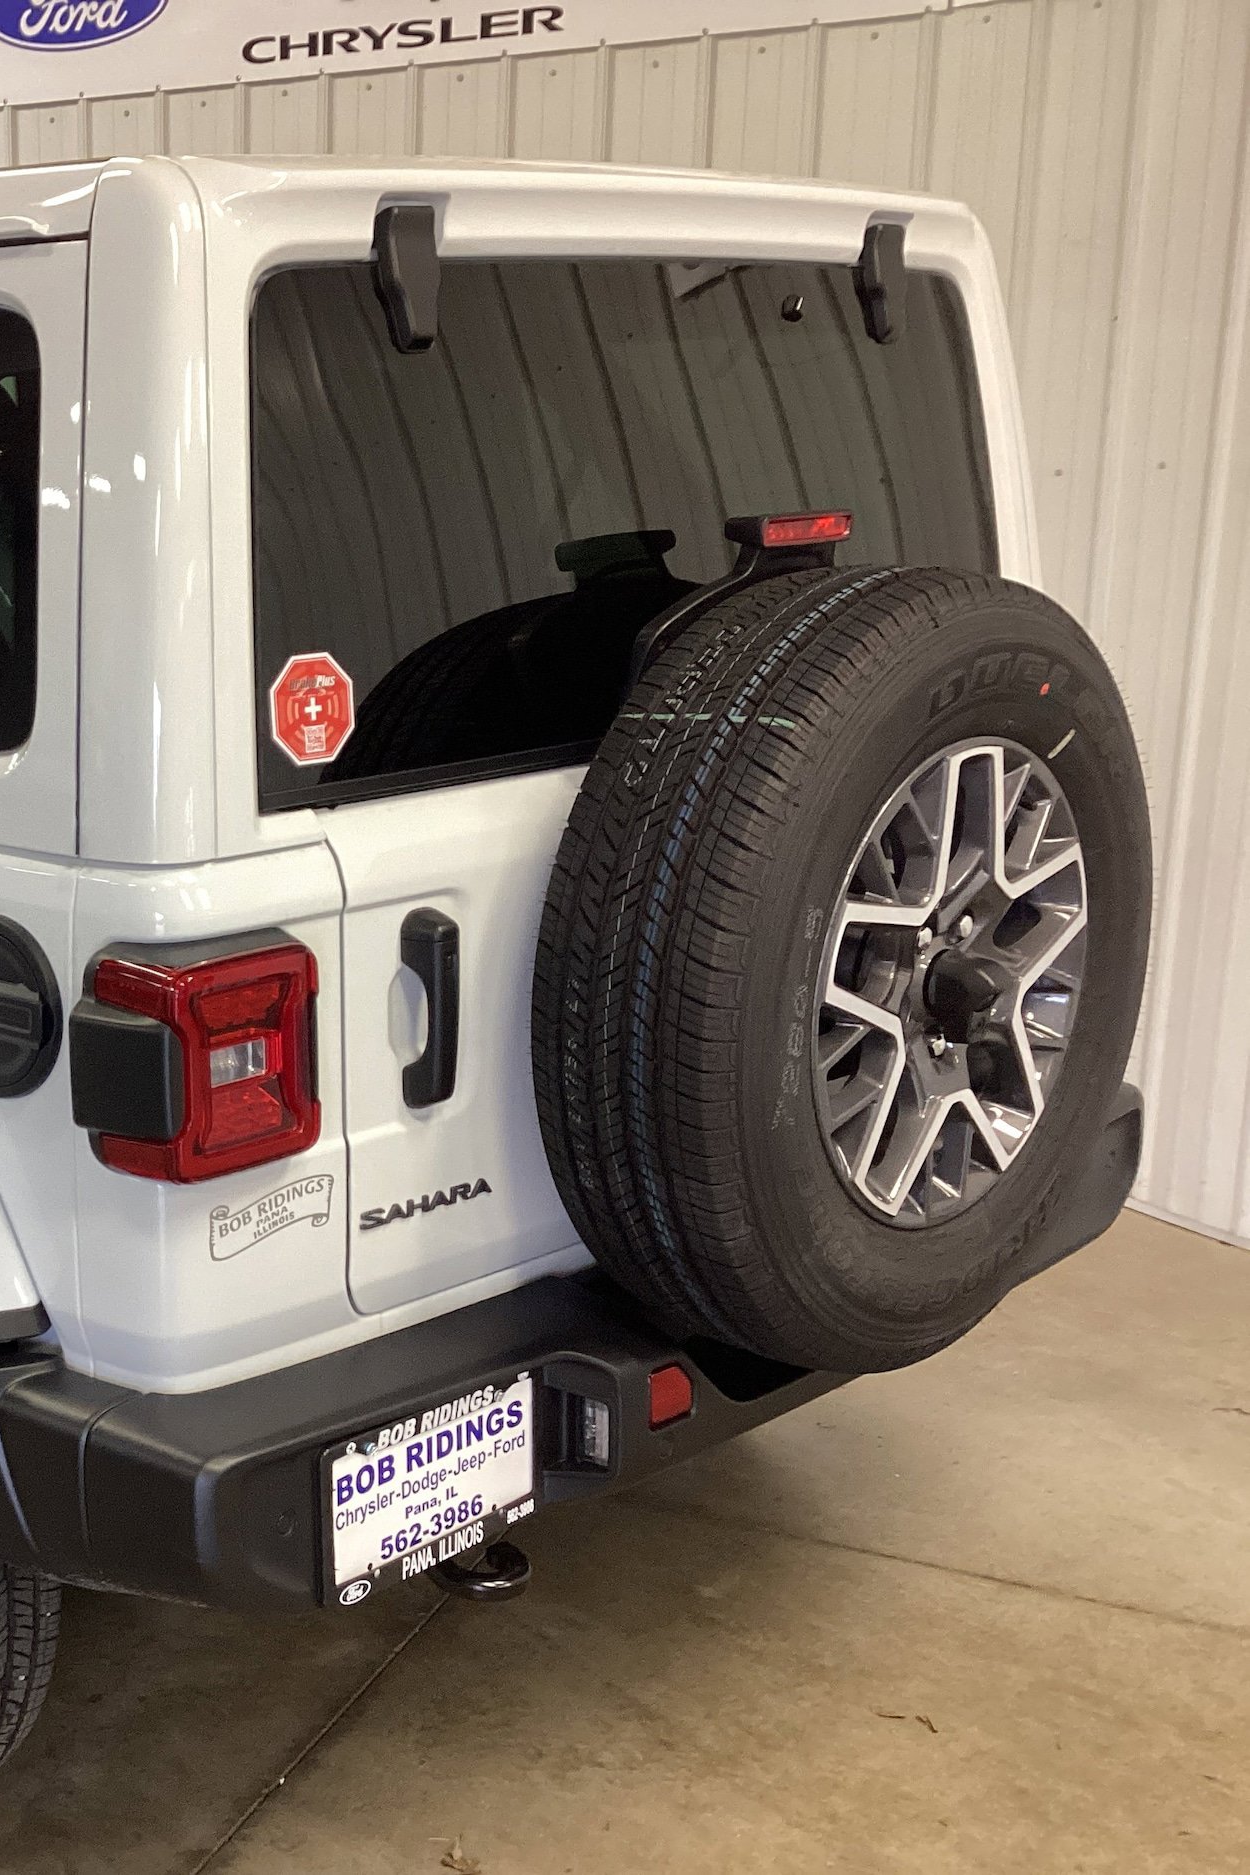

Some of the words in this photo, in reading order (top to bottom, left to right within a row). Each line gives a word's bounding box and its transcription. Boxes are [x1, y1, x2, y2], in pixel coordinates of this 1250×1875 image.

[20, 0, 128, 37] Ford
[242, 5, 565, 64] CHRYSLER
[218, 1213, 253, 1238] BOB
[257, 1178, 325, 1217] RIDINGS
[253, 1211, 295, 1240] ILLINOIS
[255, 1205, 289, 1228] PANA
[359, 1178, 493, 1231] SAHARA
[376, 1417, 417, 1450] BOB
[420, 1384, 495, 1434] RIDINGS
[335, 1429, 526, 1531] Chrysler-Dodge-Jeep-Ford
[336, 1454, 396, 1507] BOB
[406, 1399, 524, 1474] RIDINGS
[380, 1493, 484, 1561] 562-3986
[405, 1498, 442, 1520] Pana,
[445, 1485, 459, 1501] IL
[438, 1520, 485, 1563] ILLINOIS
